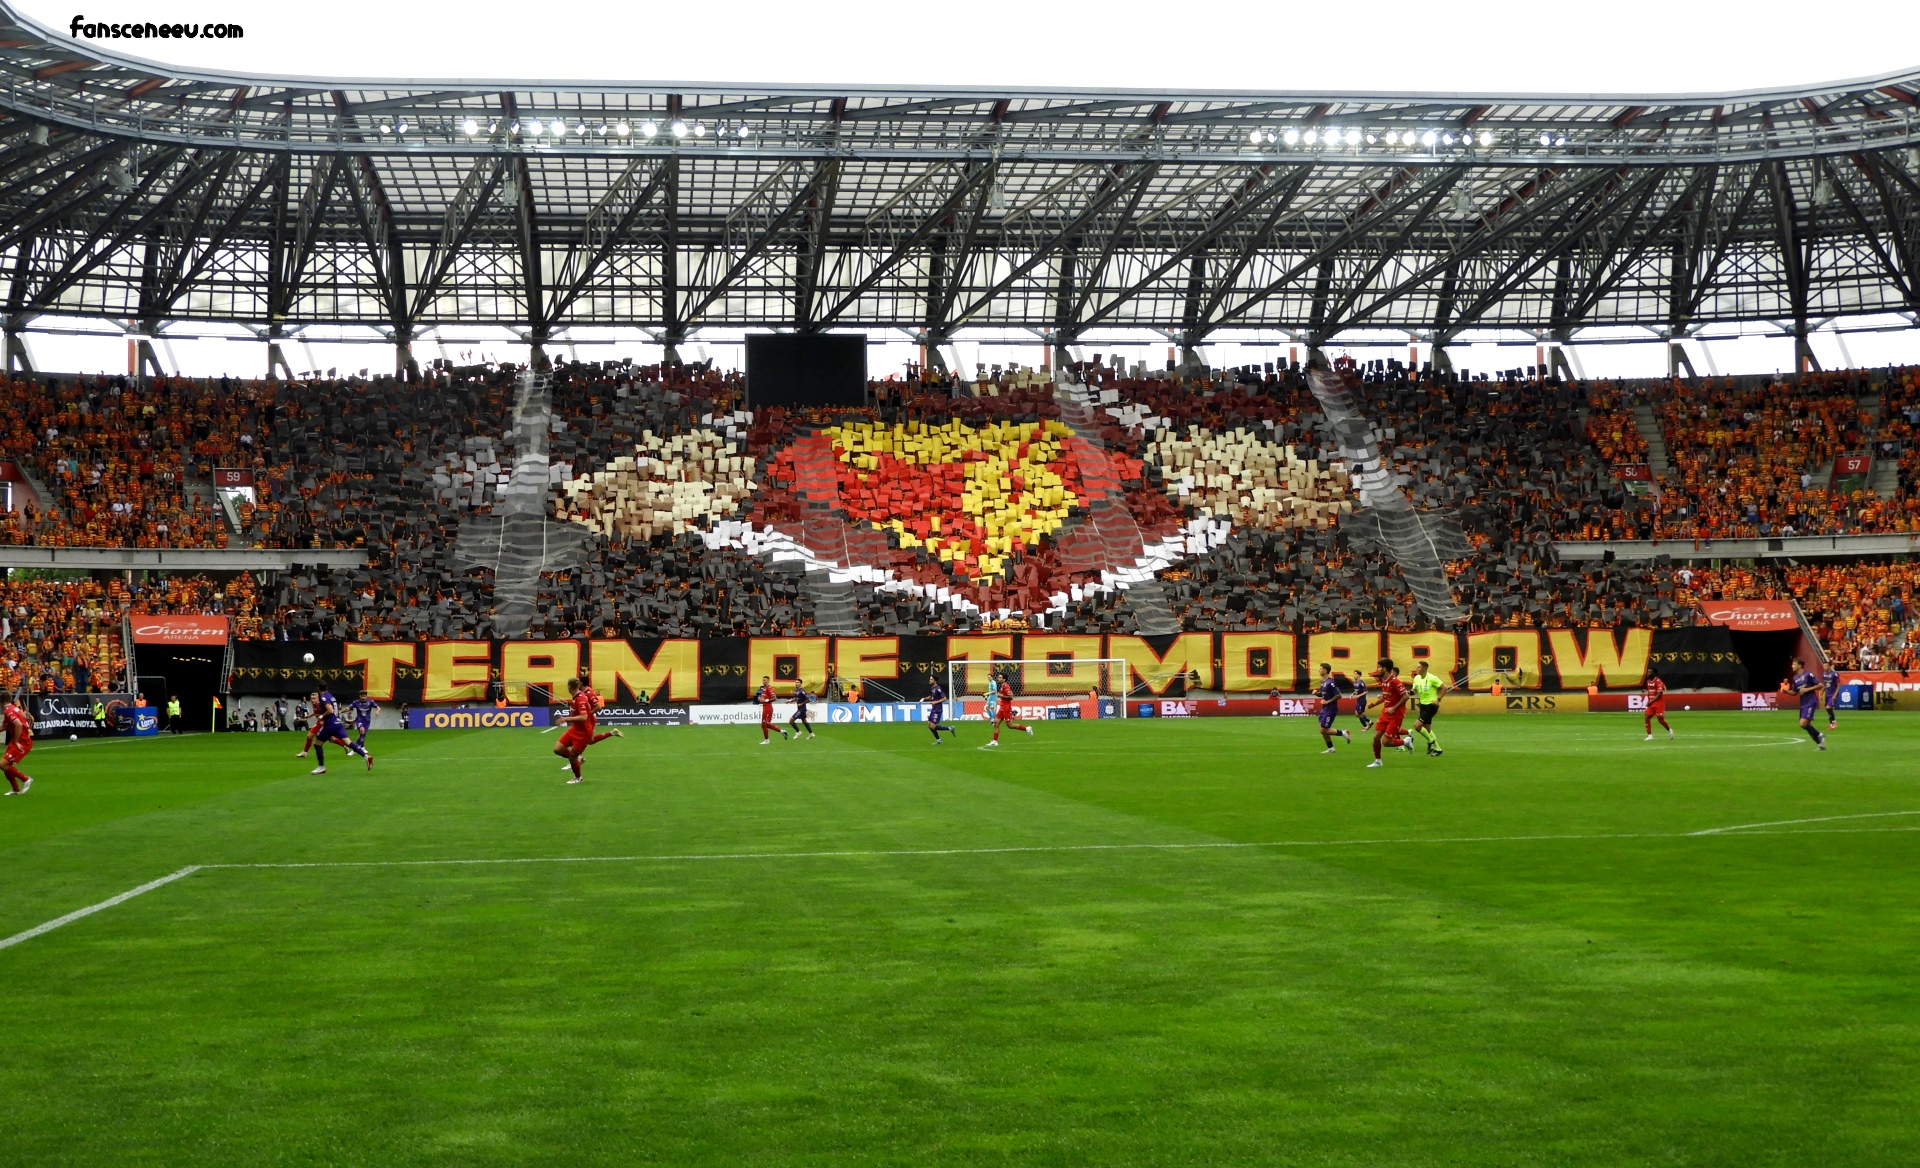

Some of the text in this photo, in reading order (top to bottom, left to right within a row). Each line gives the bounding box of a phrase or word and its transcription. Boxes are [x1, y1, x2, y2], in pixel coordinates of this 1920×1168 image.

[1848, 460, 1861, 470] 57
[226, 471, 240, 482] 59
[1710, 610, 1792, 621] Chorten
[135, 625, 225, 636] Chorten
[344, 627, 1654, 704] TEAM OF TOMORROW
[1526, 695, 1556, 709] RS
[649, 708, 686, 716] GRUPA
[424, 711, 534, 728] romicore
